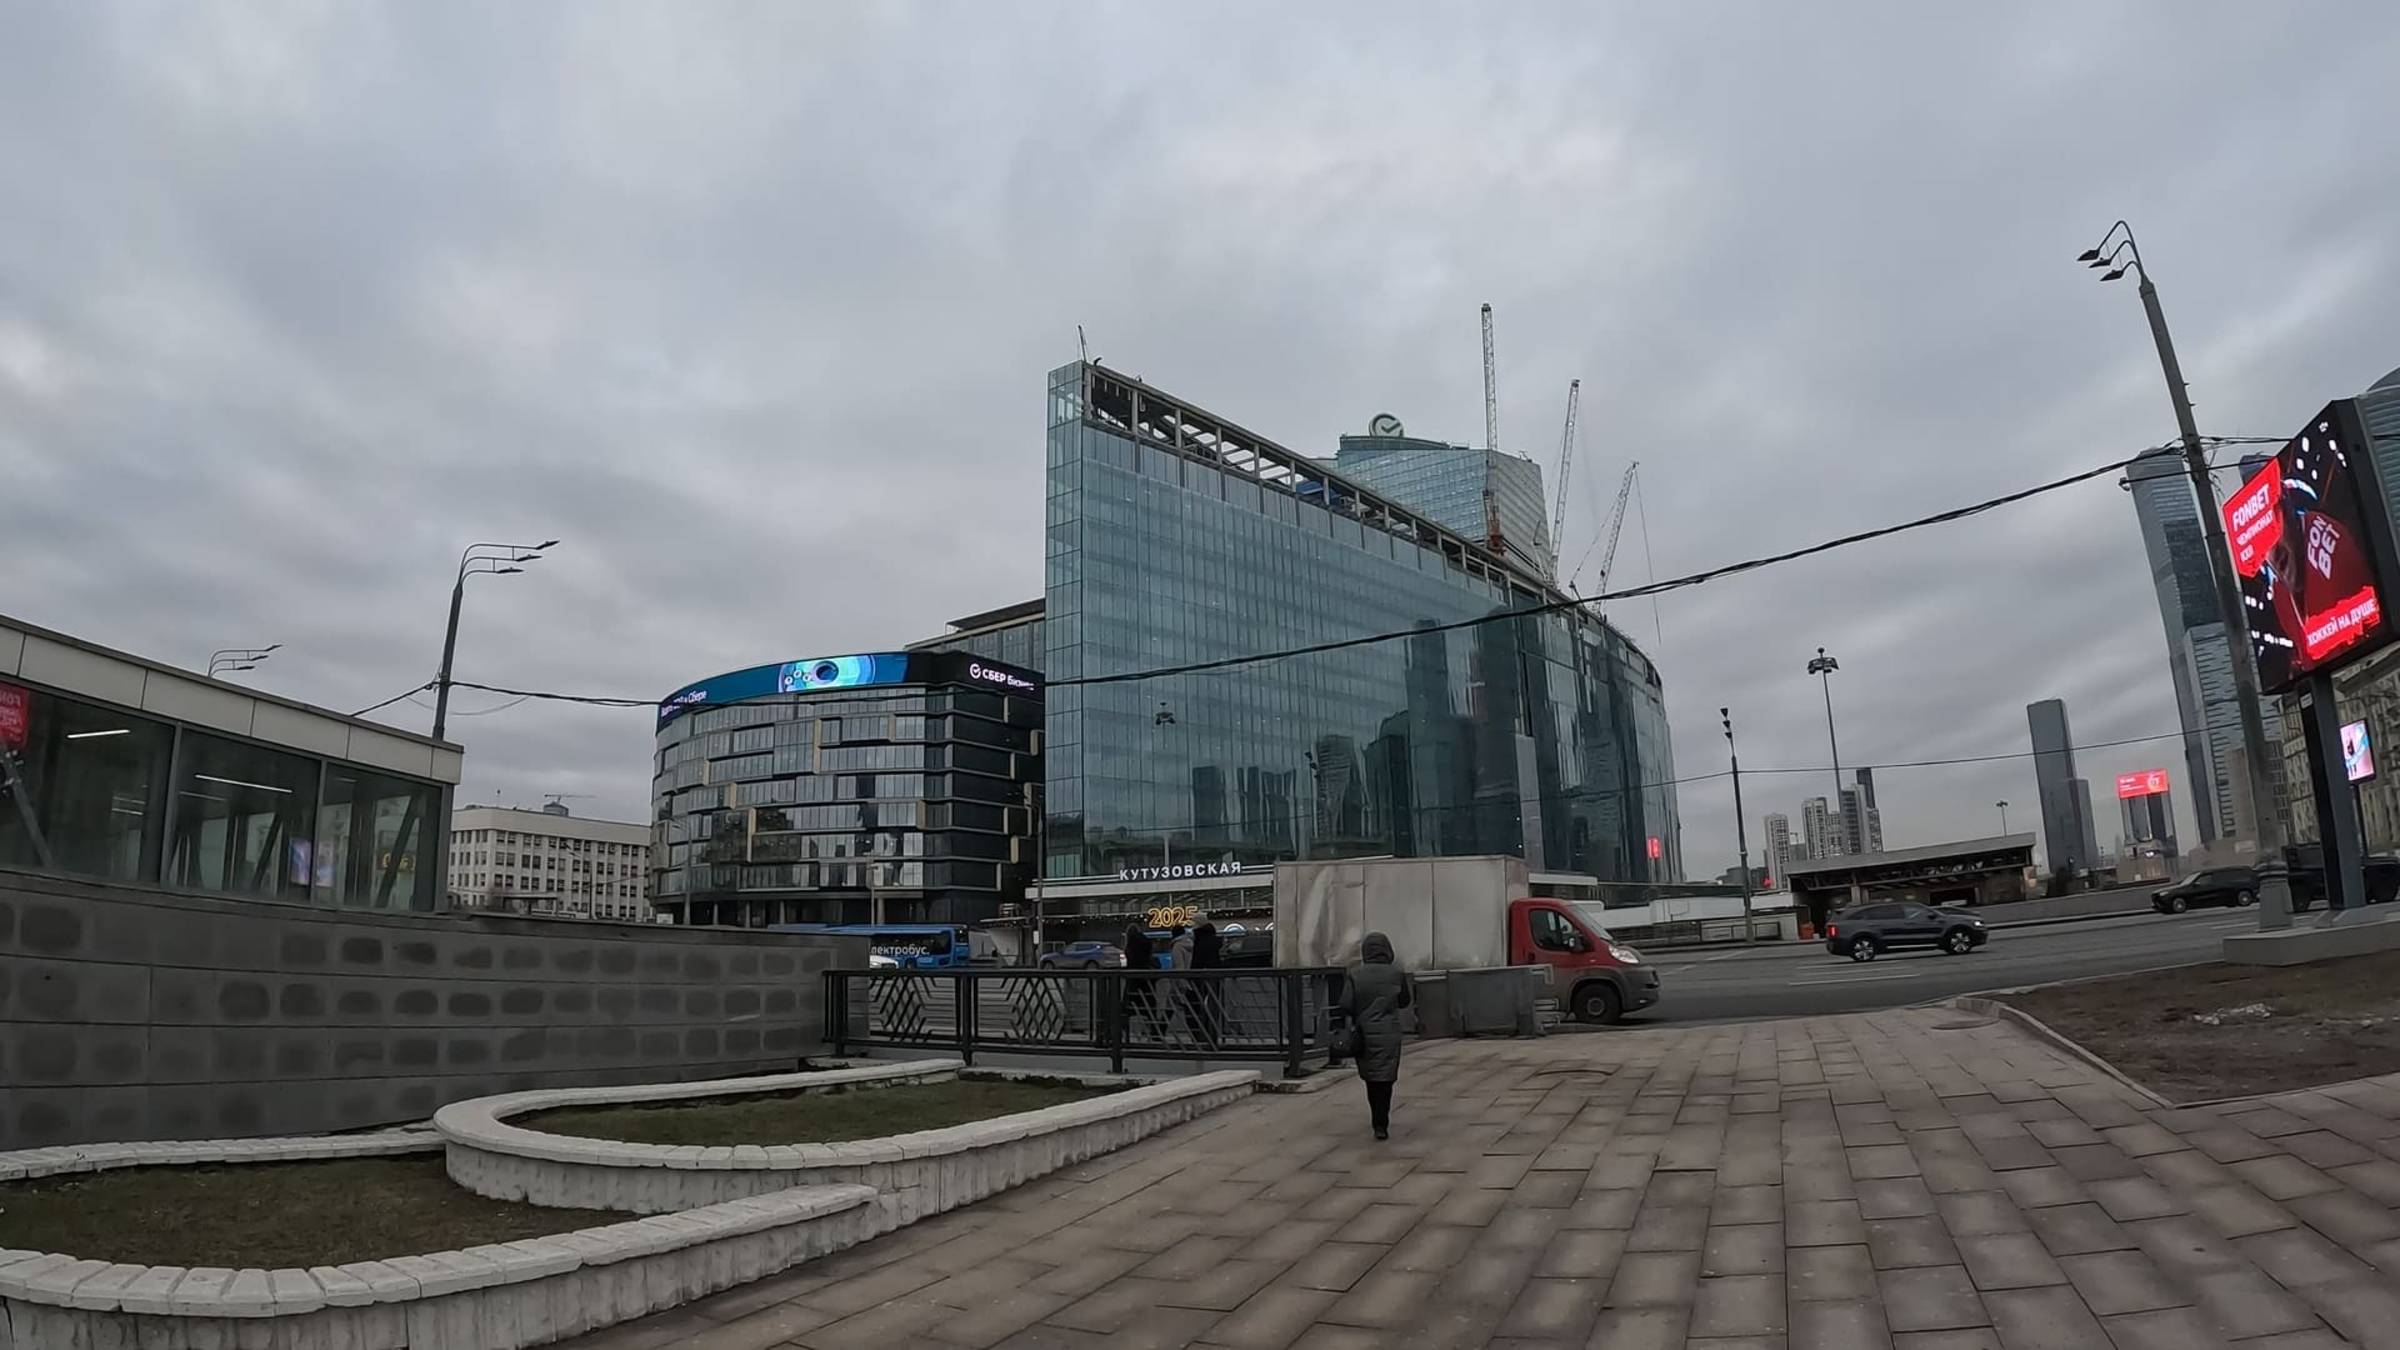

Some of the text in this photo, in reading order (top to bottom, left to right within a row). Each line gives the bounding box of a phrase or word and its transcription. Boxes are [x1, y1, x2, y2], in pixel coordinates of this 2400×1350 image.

[2232, 483, 2270, 532] FONBET
[2307, 515, 2327, 570] FON
[2318, 523, 2341, 580] BET
[2337, 613, 2351, 630] НА
[982, 668, 1006, 683] СБЕР
[1119, 861, 1242, 881] КУТУЗОВСКАЯ
[1148, 905, 1199, 928] 2025
[871, 943, 930, 958] лектробус.
